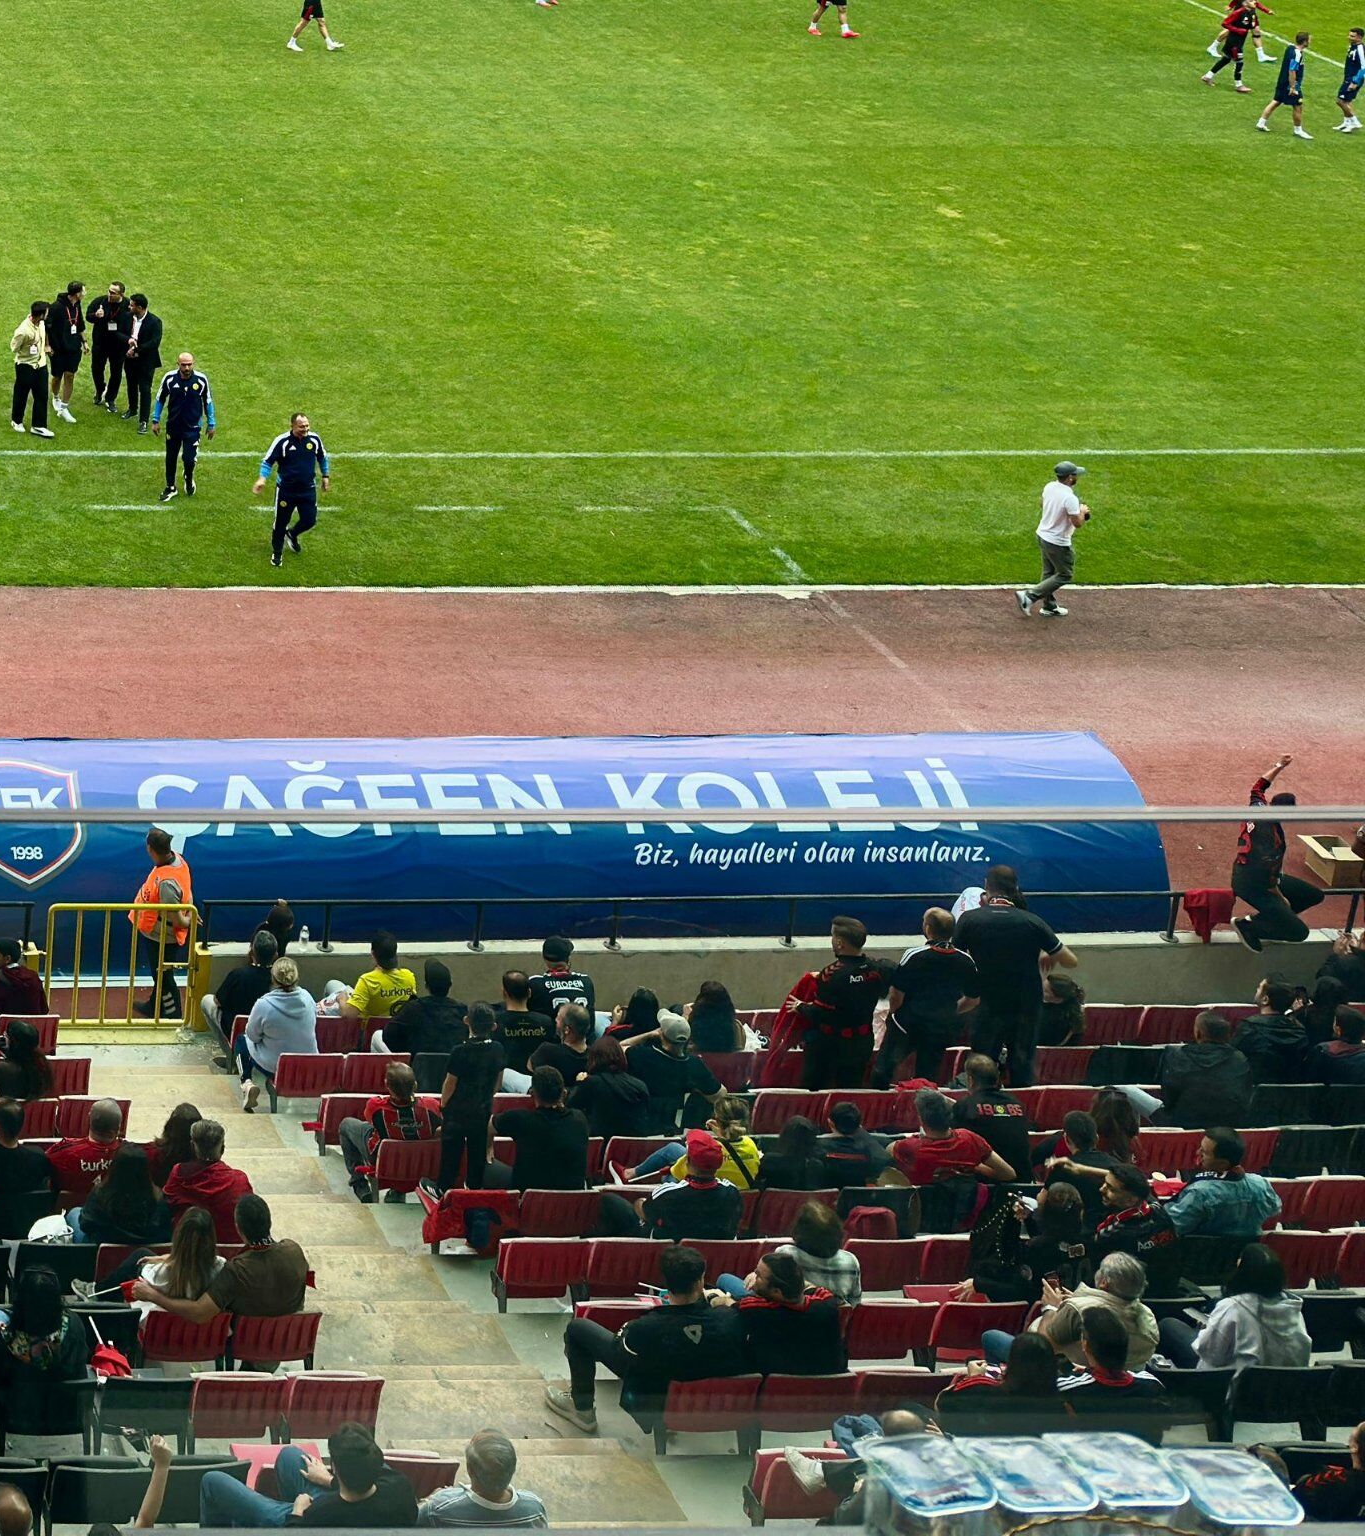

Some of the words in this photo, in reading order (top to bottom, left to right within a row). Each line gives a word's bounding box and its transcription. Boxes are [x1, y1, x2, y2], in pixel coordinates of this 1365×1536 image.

[604, 758, 981, 836] KOLEJİ
[10, 845, 43, 862] 1998
[634, 842, 679, 869] Biz,
[689, 841, 798, 870] hayalleri
[804, 841, 854, 864] olan
[864, 840, 992, 864] insanlarız.
[545, 979, 584, 989] EUROPEN
[505, 1026, 547, 1037] turknet
[80, 1158, 114, 1173] turk
